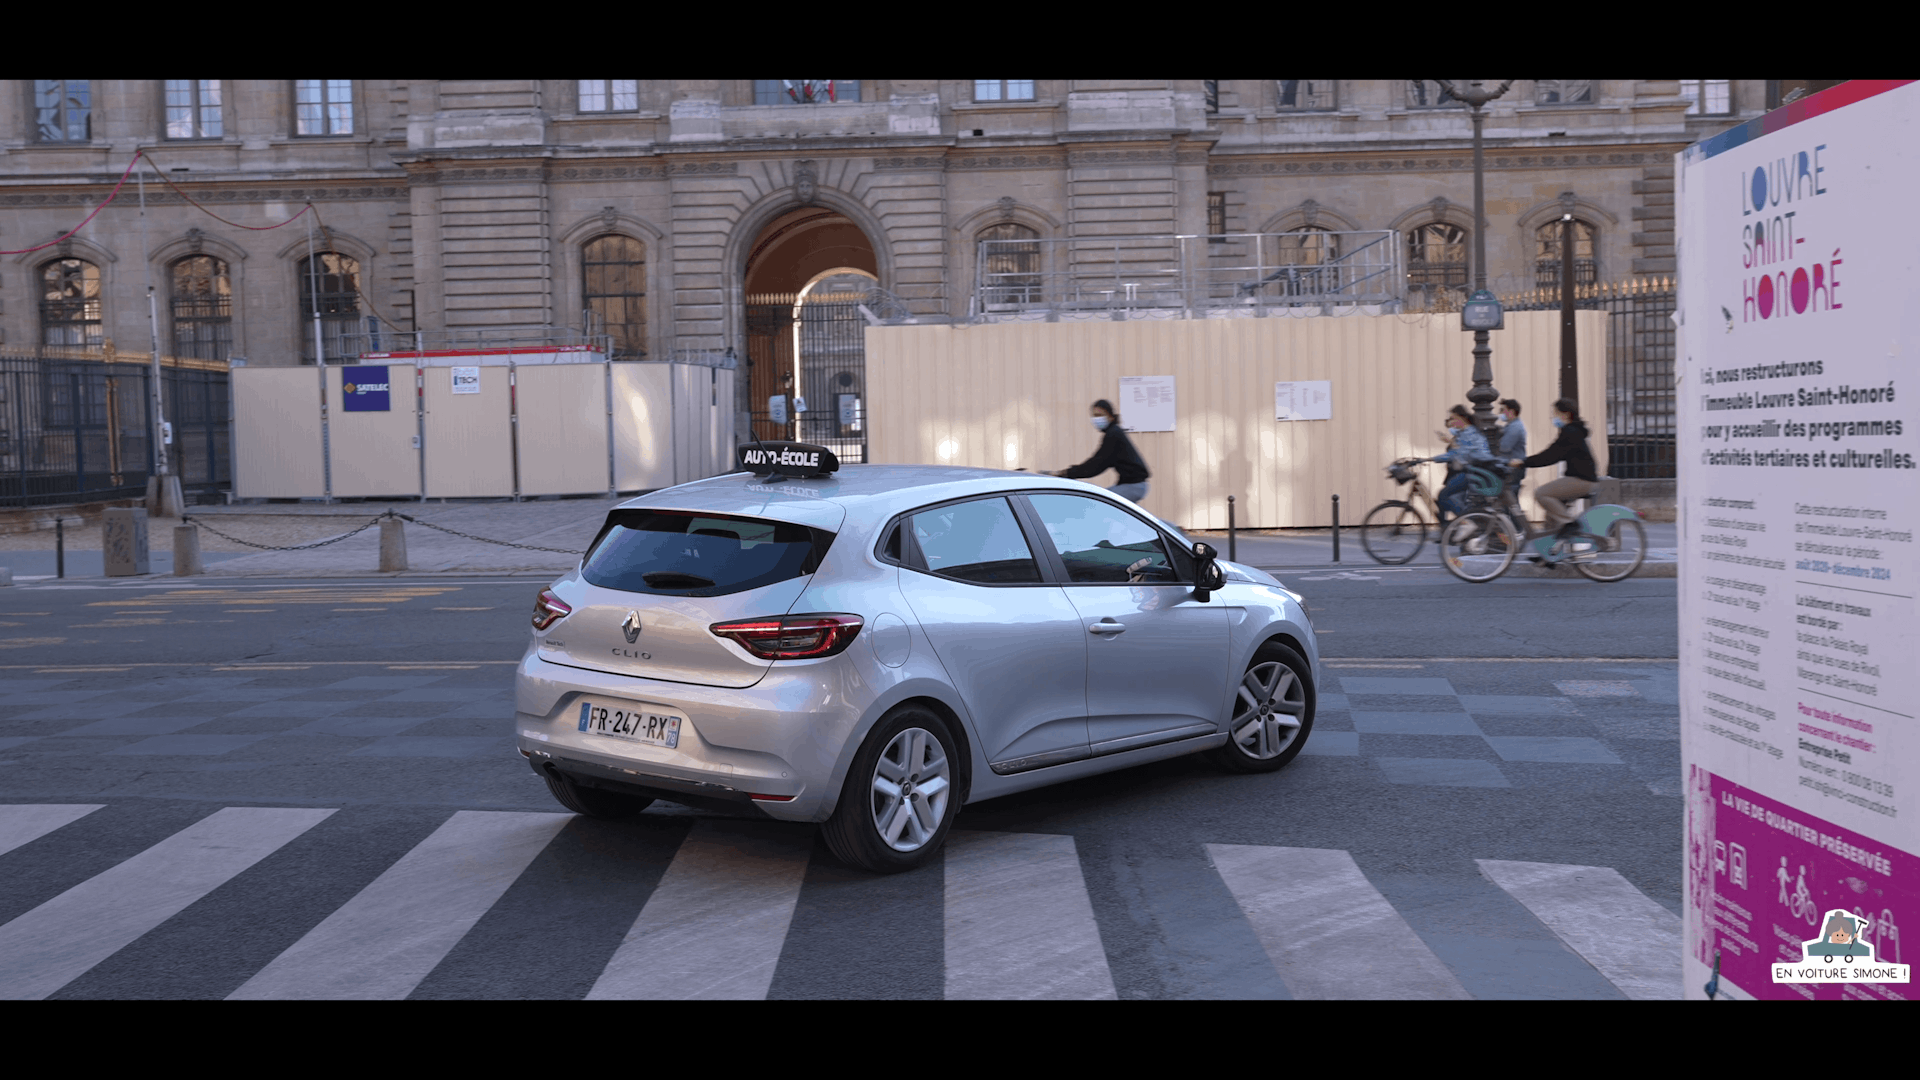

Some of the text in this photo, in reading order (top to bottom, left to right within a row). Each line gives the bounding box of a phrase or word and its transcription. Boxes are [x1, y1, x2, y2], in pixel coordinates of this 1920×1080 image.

[1742, 144, 1827, 216] LOUVRE
[1743, 211, 1806, 269] SAINT-
[1743, 247, 1843, 323] HONORÉ
[1716, 368, 1739, 384] nous
[1740, 360, 1823, 382] restructurons
[356, 383, 389, 392] SATELEC
[1755, 391, 1795, 409] Louvre
[1797, 380, 1895, 407] Saint-Honoré
[1732, 419, 1781, 438] accueillir
[1784, 419, 1806, 437] des
[1809, 419, 1903, 441] programmes
[1754, 449, 1810, 467] tertiaires
[1812, 450, 1826, 468] et
[1829, 449, 1917, 470] culturelles.
[612, 648, 652, 660] CLIO
[589, 706, 668, 741] FR-247-RX
[665, 731, 676, 744] 78
[1721, 791, 1892, 877] LA VIE DE QUARTIER PRÉSERVÉE
